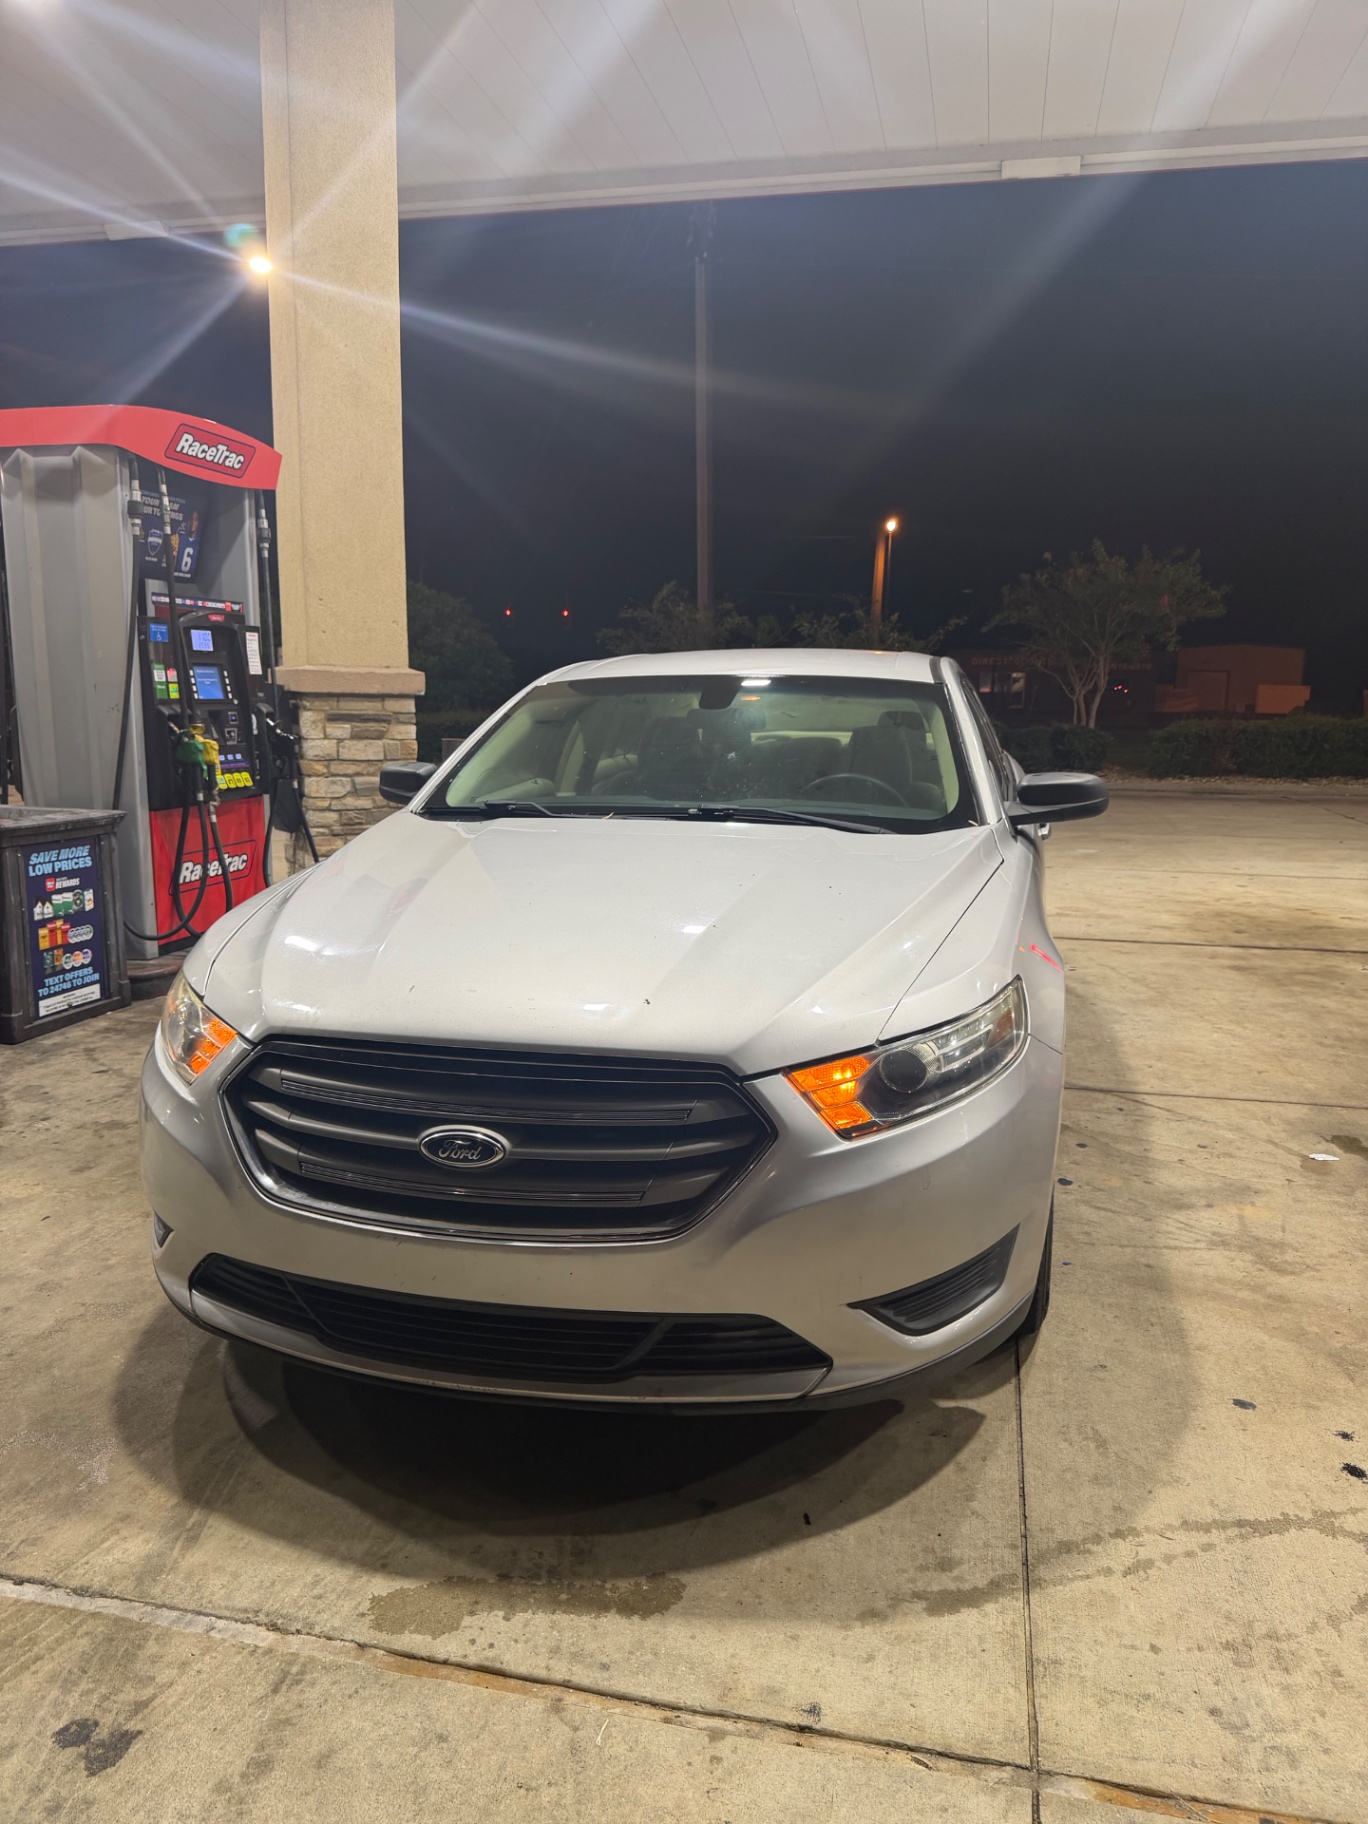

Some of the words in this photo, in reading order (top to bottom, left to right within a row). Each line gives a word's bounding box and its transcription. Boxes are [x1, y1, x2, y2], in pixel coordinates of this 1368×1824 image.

[175, 432, 245, 469] RaceTrac
[181, 547, 194, 572] 6
[29, 849, 59, 865] SAVE
[58, 845, 90, 860] MORE
[28, 862, 53, 877] LOW
[54, 856, 92, 873] PRICES
[179, 853, 248, 884] Raerac
[55, 878, 80, 889] REWARDS
[38, 987, 49, 997] TO
[72, 977, 82, 987] TO
[83, 972, 100, 984] JOIN
[44, 974, 64, 986] TEXT
[64, 966, 93, 981] OFFERS
[438, 1140, 482, 1160] Ford
